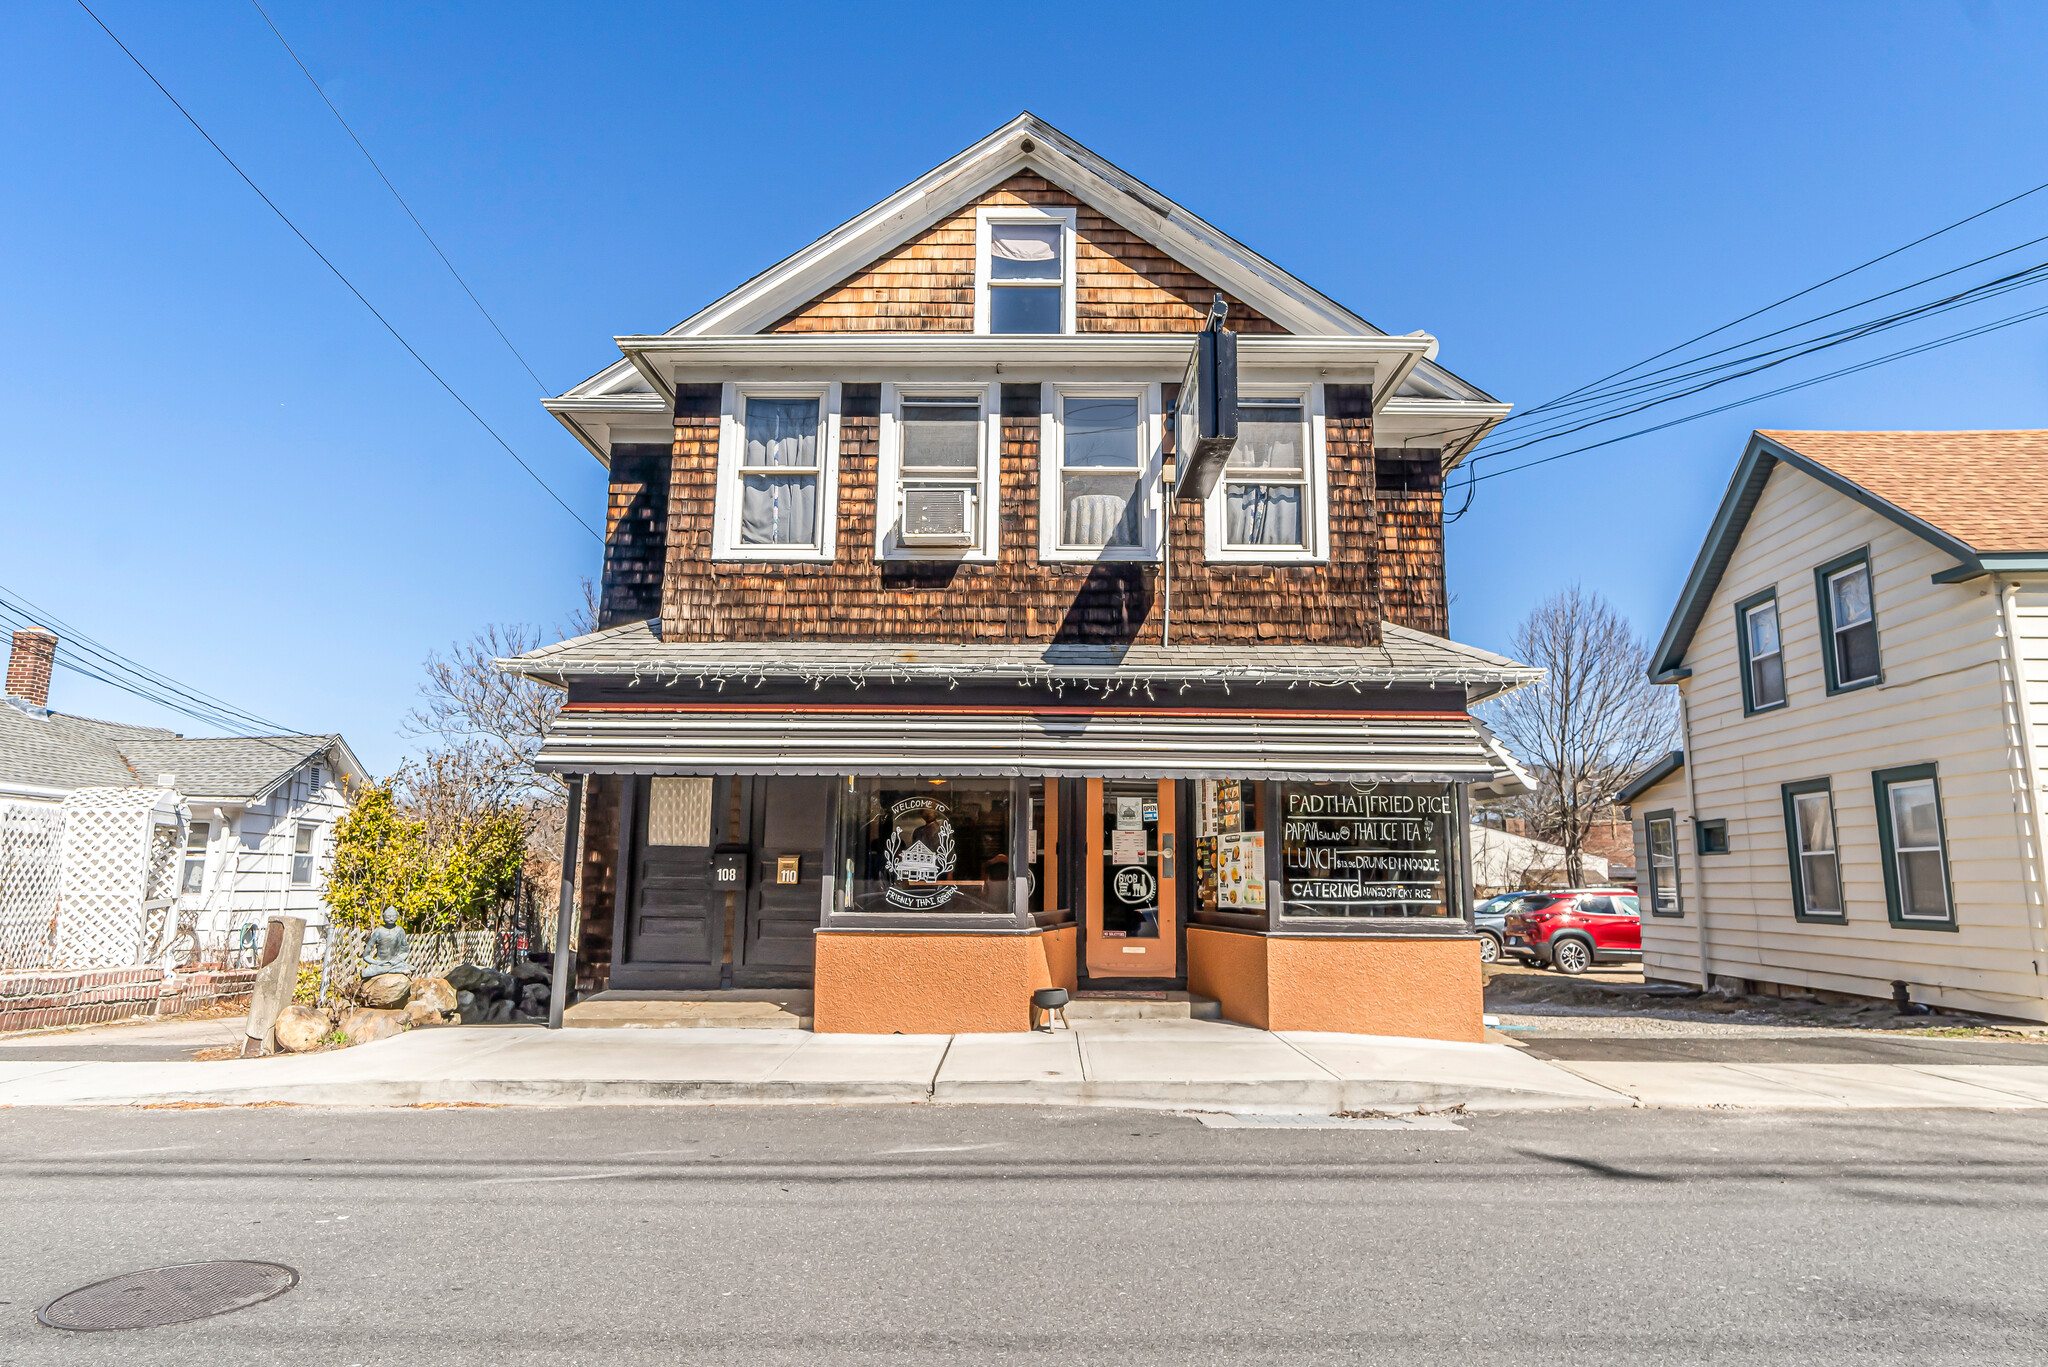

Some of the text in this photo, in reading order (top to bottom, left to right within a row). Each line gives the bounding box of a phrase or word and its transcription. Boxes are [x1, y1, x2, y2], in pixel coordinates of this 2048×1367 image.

[892, 800, 945, 814] WELCOME TO
[1371, 796, 1451, 814] FRIED RICE
[1285, 822, 1340, 842] PAPAYA SALAD
[1354, 822, 1421, 841] THAI ICE TEA
[1287, 848, 1337, 870] LUNCH
[717, 868, 736, 881] 108
[781, 870, 796, 882] 110
[1119, 873, 1138, 884] BYOB
[1292, 881, 1359, 898] CATERING
[1415, 889, 1431, 899] RICE
[916, 897, 936, 907] THAI
